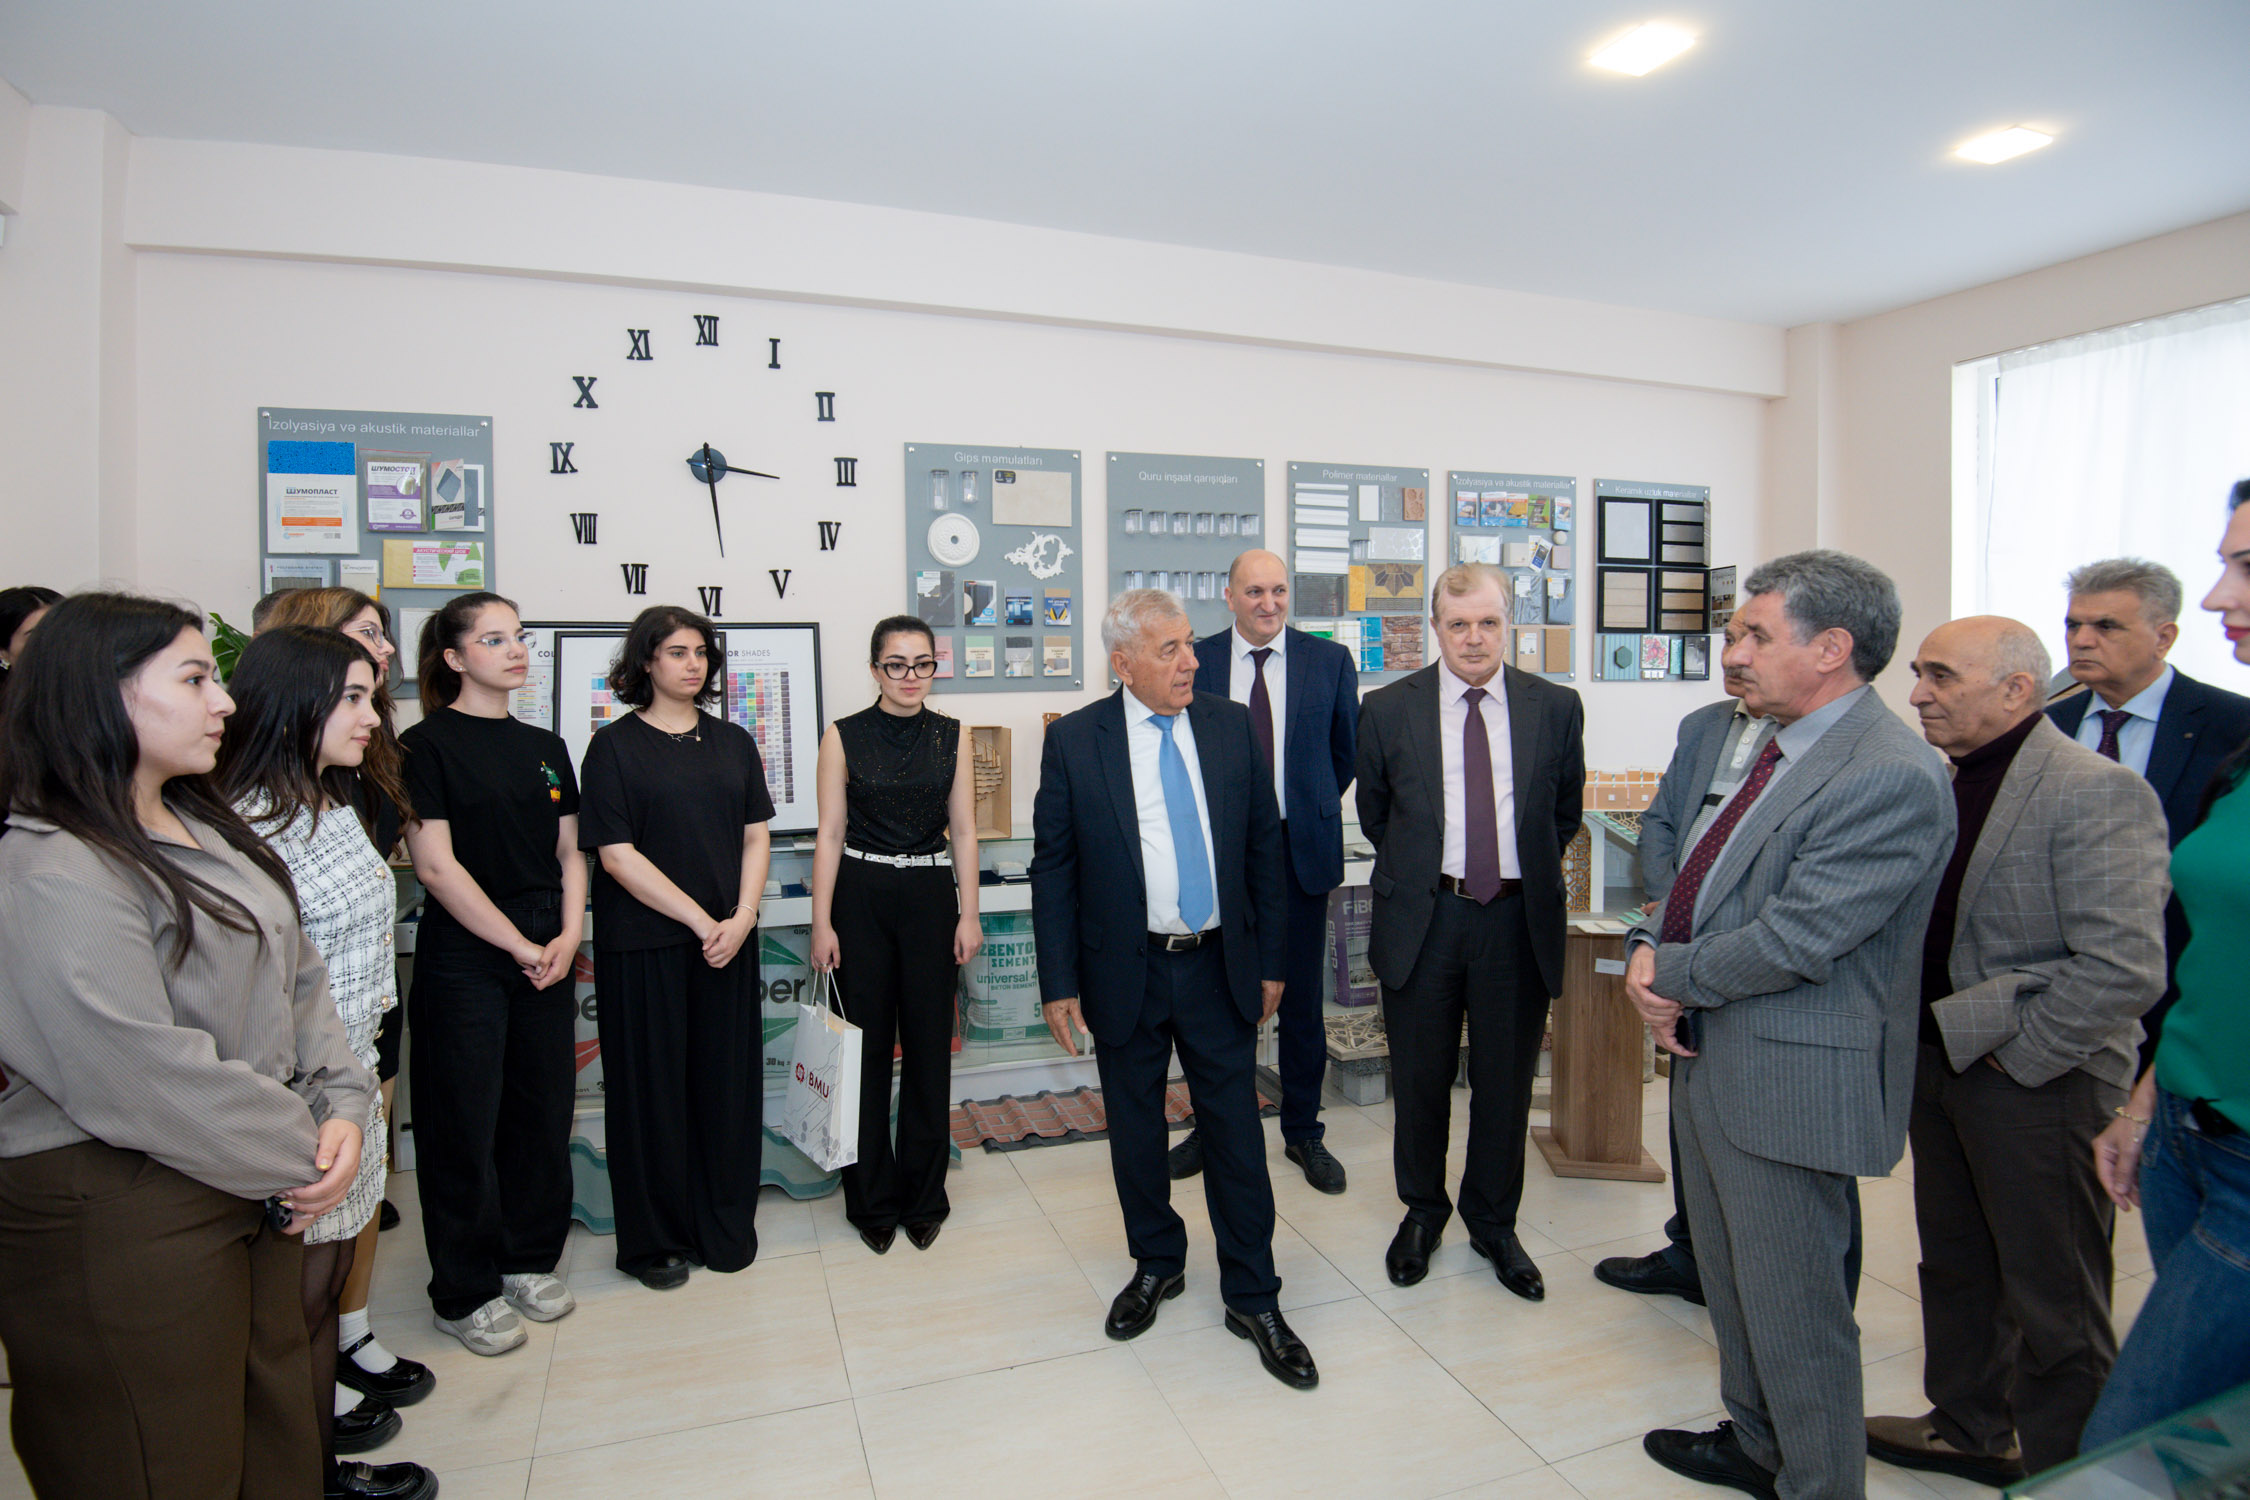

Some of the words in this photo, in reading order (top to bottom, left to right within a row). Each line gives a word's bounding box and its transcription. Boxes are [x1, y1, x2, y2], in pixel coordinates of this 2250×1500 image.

[626, 328, 653, 360] XI
[693, 314, 719, 346] XII
[768, 338, 781, 369] I
[572, 376, 598, 408] X
[815, 391, 835, 422] II
[340, 424, 355, 433] və
[360, 422, 407, 434] akustik
[411, 424, 480, 437] materiallar
[549, 442, 578, 474] IX
[834, 457, 858, 487] III
[954, 451, 979, 464] Gips
[1138, 471, 1161, 481] Quru
[1322, 469, 1353, 480] Polimer
[1356, 472, 1398, 482] materiallar
[1505, 479, 1531, 488] akustik
[1533, 481, 1571, 490] materiallar
[570, 513, 598, 544] VIII
[818, 521, 841, 551] IV
[621, 563, 649, 595] VII
[769, 569, 792, 599] V
[698, 586, 723, 617] VI
[741, 649, 771, 657] SHADES
[976, 941, 1036, 957] ZBENTO
[976, 970, 1029, 984] universal
[808, 1071, 830, 1098] BMU
